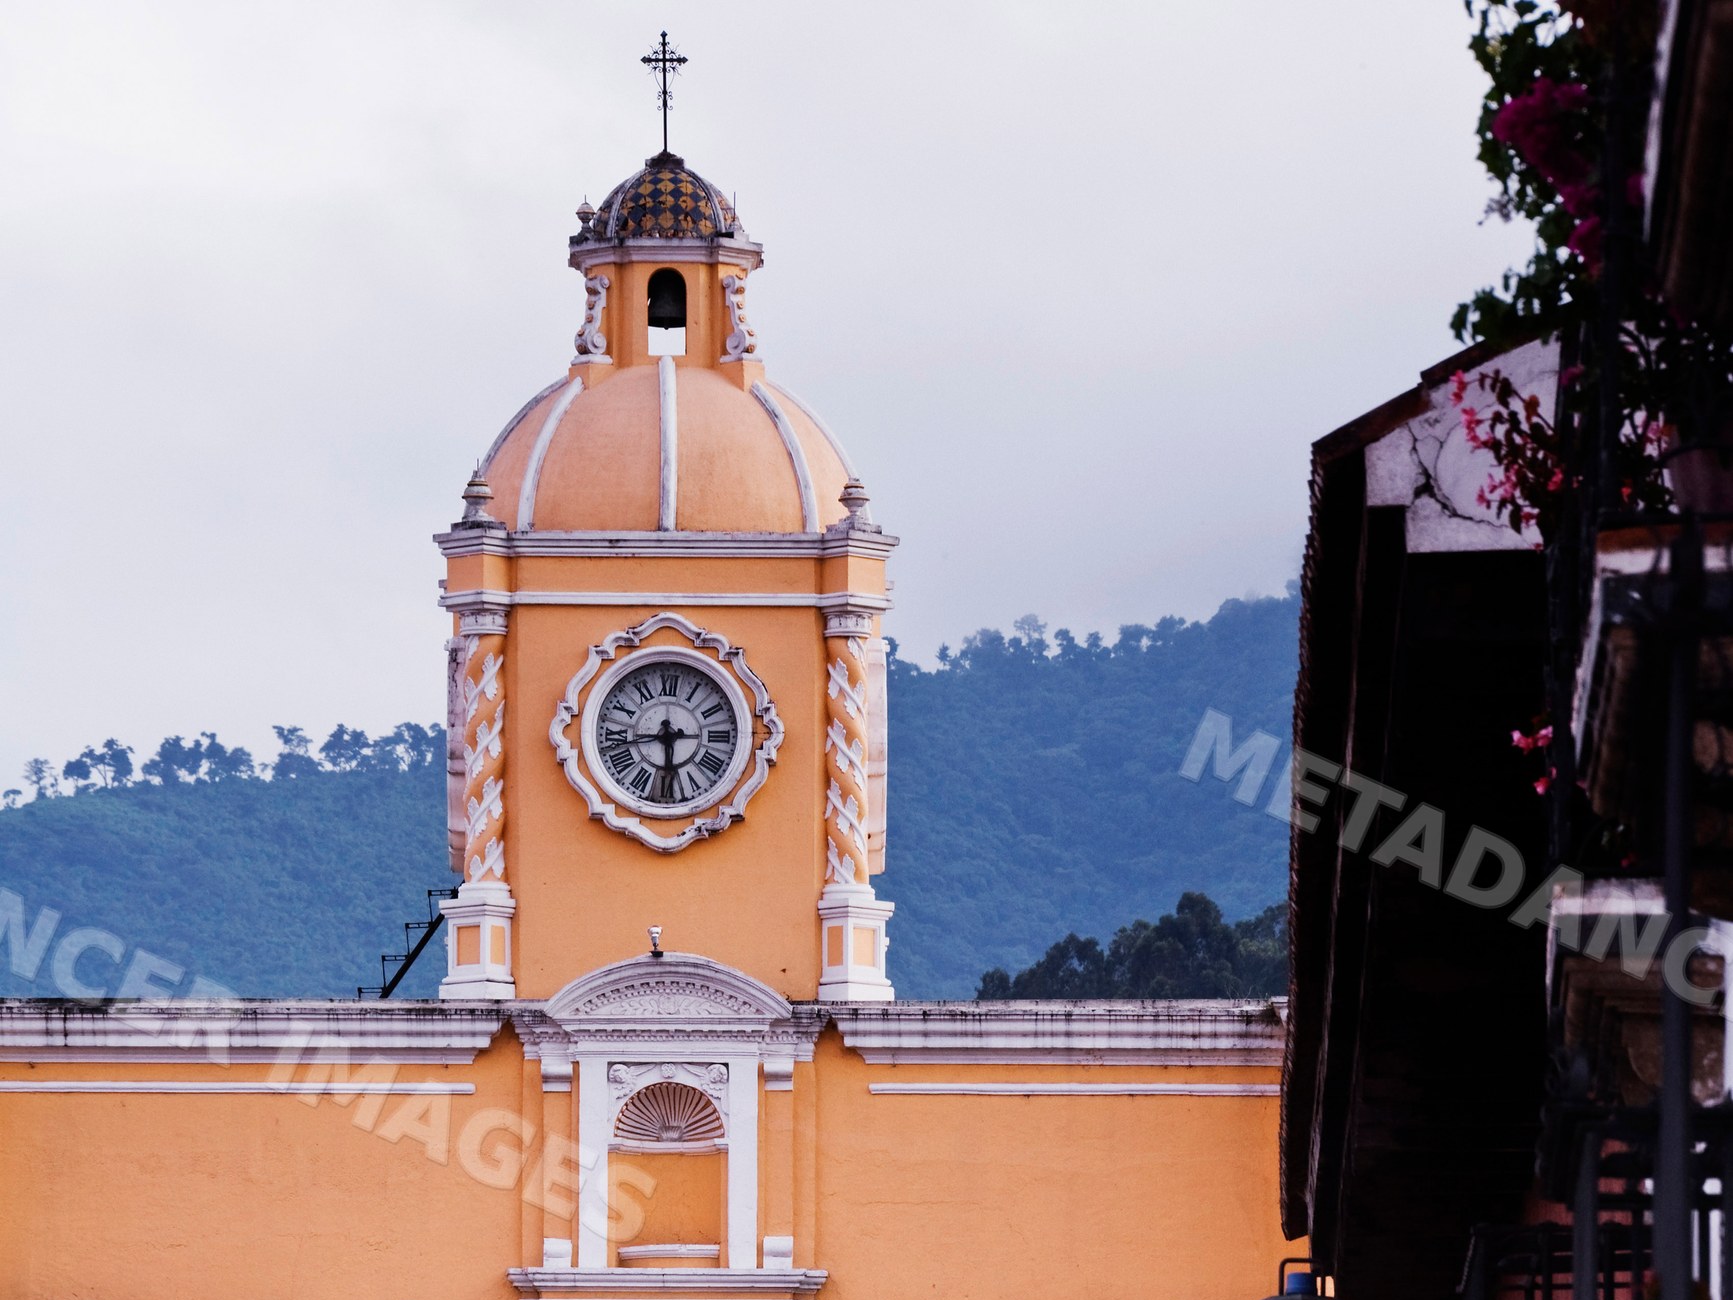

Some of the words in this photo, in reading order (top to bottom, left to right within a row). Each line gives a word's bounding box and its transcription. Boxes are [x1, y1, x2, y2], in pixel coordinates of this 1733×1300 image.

[632, 678, 655, 705] XI
[658, 673, 681, 697] XII
[685, 681, 702, 703] I
[612, 699, 637, 719] X
[701, 702, 724, 720] II
[707, 729, 730, 744] III
[629, 766, 653, 794] VII
[686, 770, 702, 793] V
